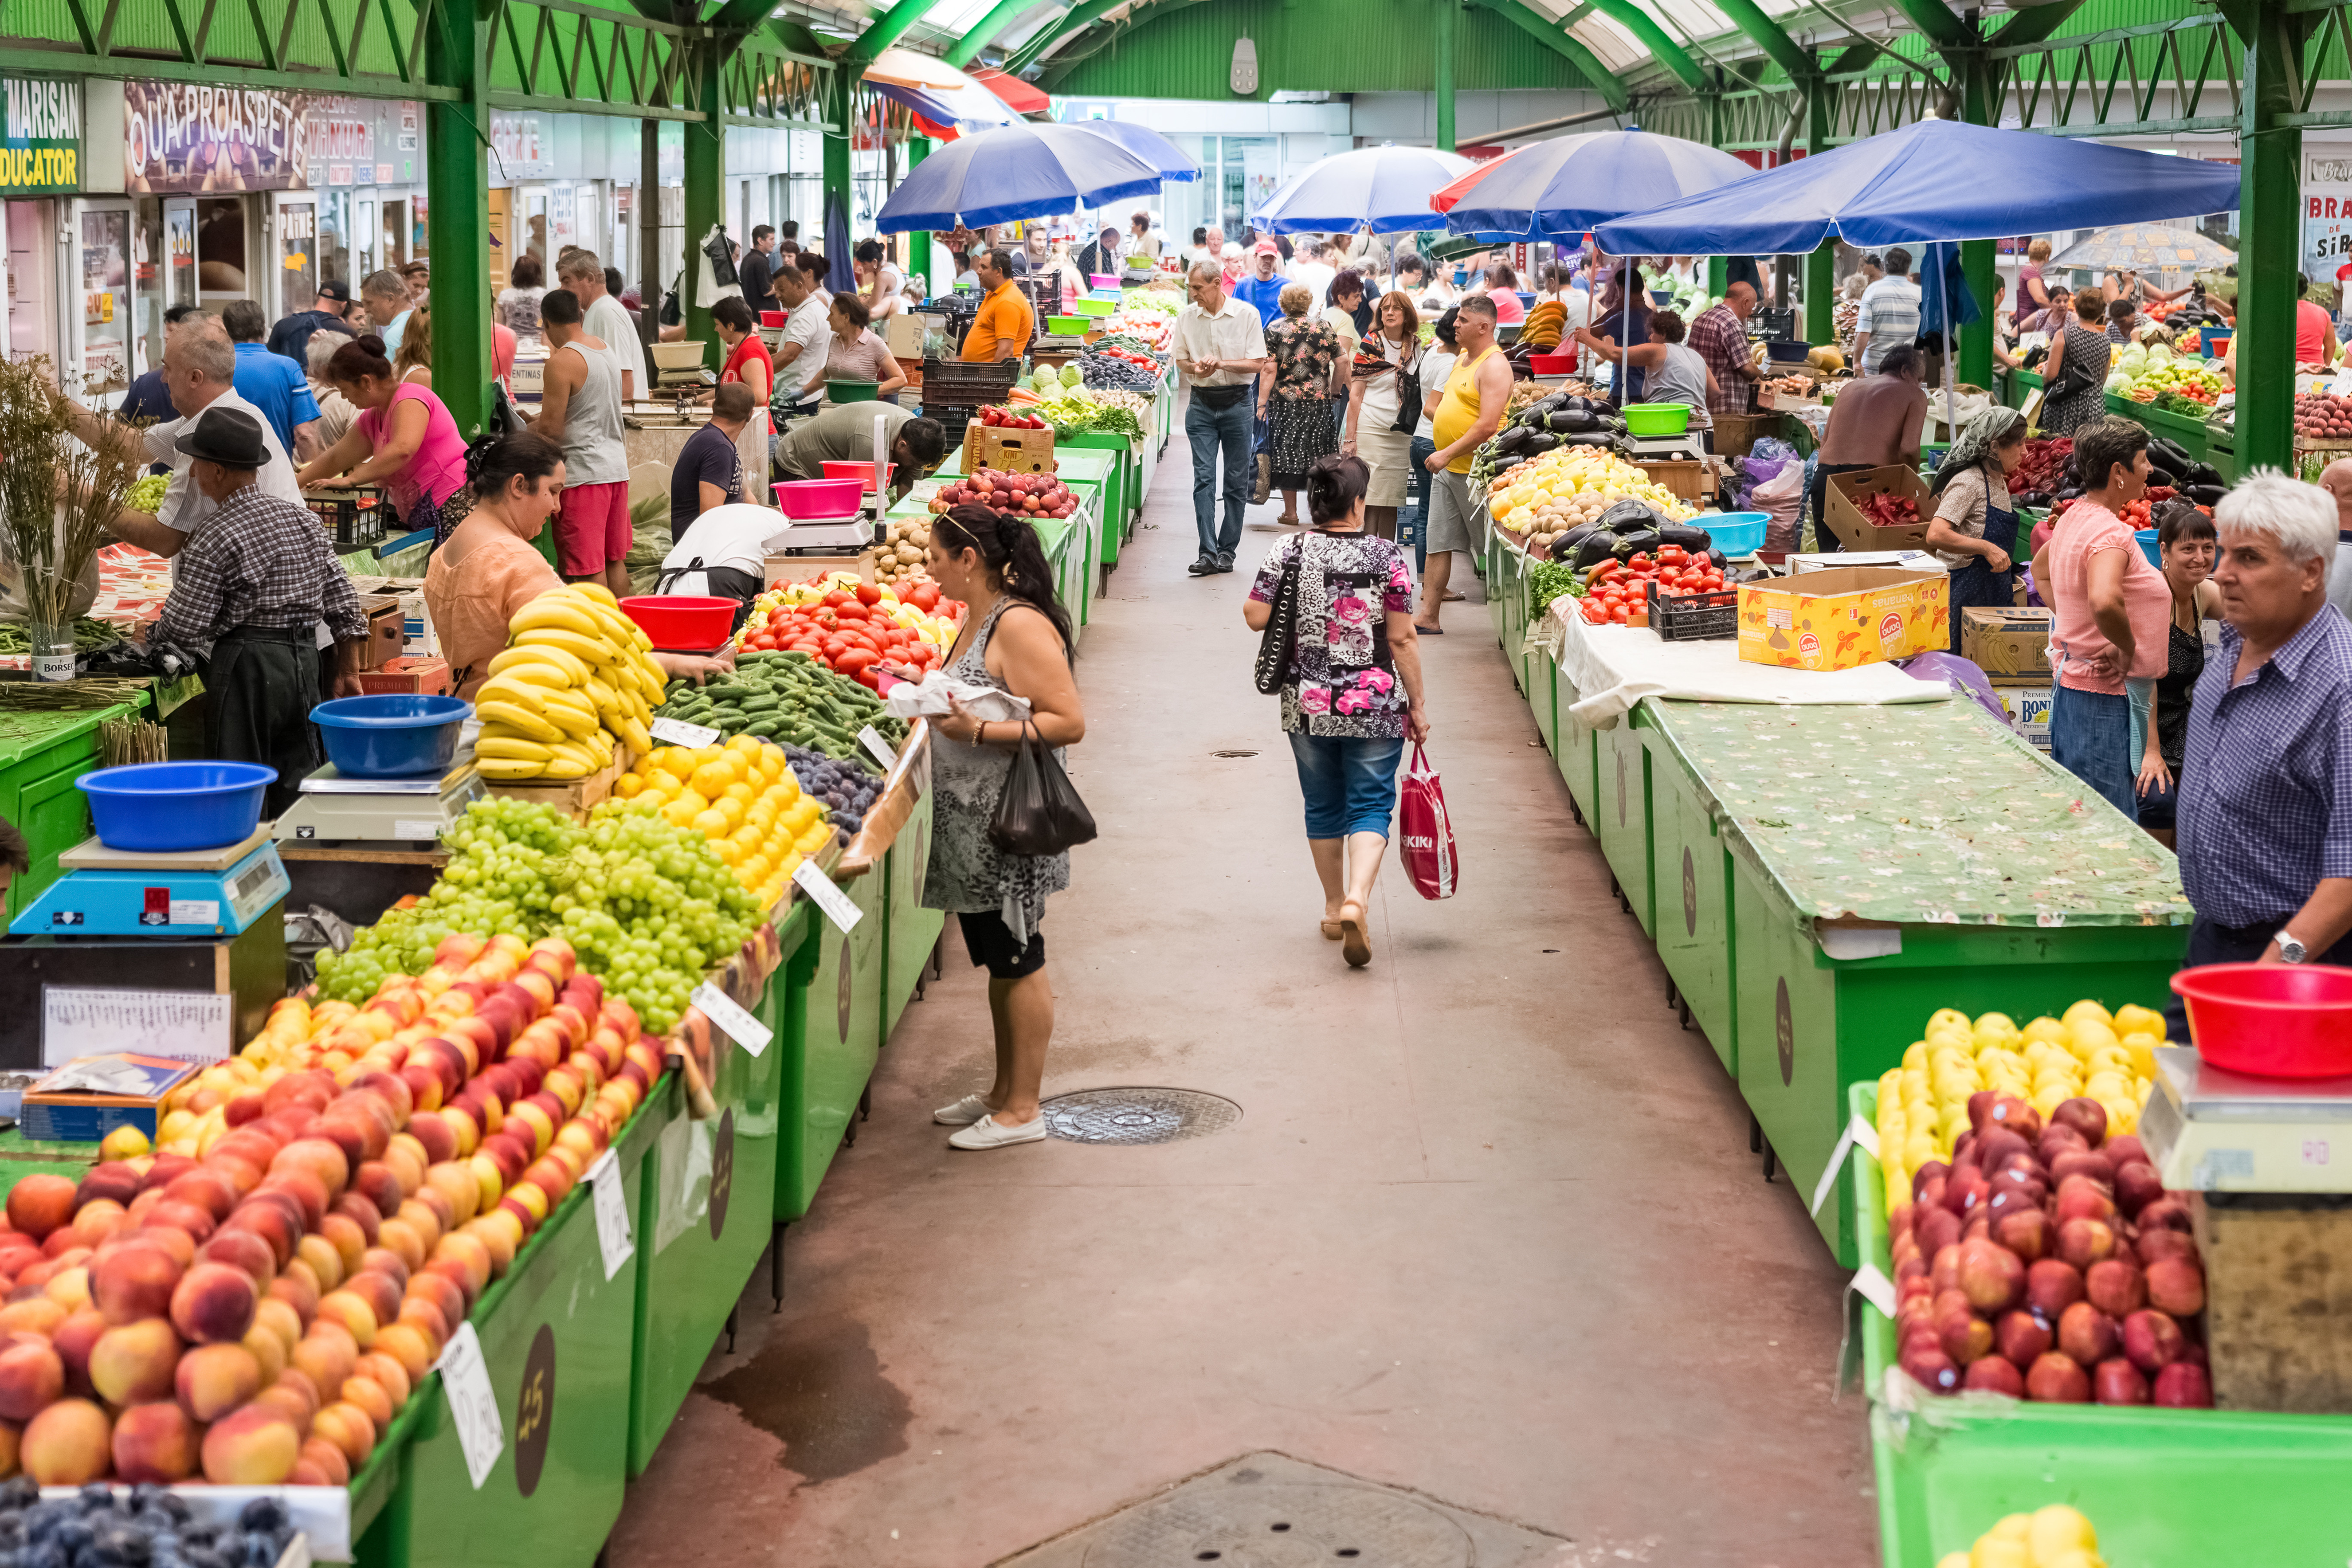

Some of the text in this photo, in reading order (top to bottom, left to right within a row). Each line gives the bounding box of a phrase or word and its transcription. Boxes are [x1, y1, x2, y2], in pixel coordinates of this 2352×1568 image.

[185, 85, 305, 179] PROASPETE
[0, 149, 77, 186] DUCATOR
[2329, 224, 2340, 233] DE
[512, 370, 541, 379] ENTINAS
[1872, 593, 1914, 608] bananas
[1739, 629, 1766, 642] bananas
[1882, 622, 1901, 636] bana
[1802, 642, 1817, 650] bana
[44, 663, 74, 672] BORSEC
[368, 682, 412, 690] PREMIUM
[2021, 701, 2051, 723] BONI
